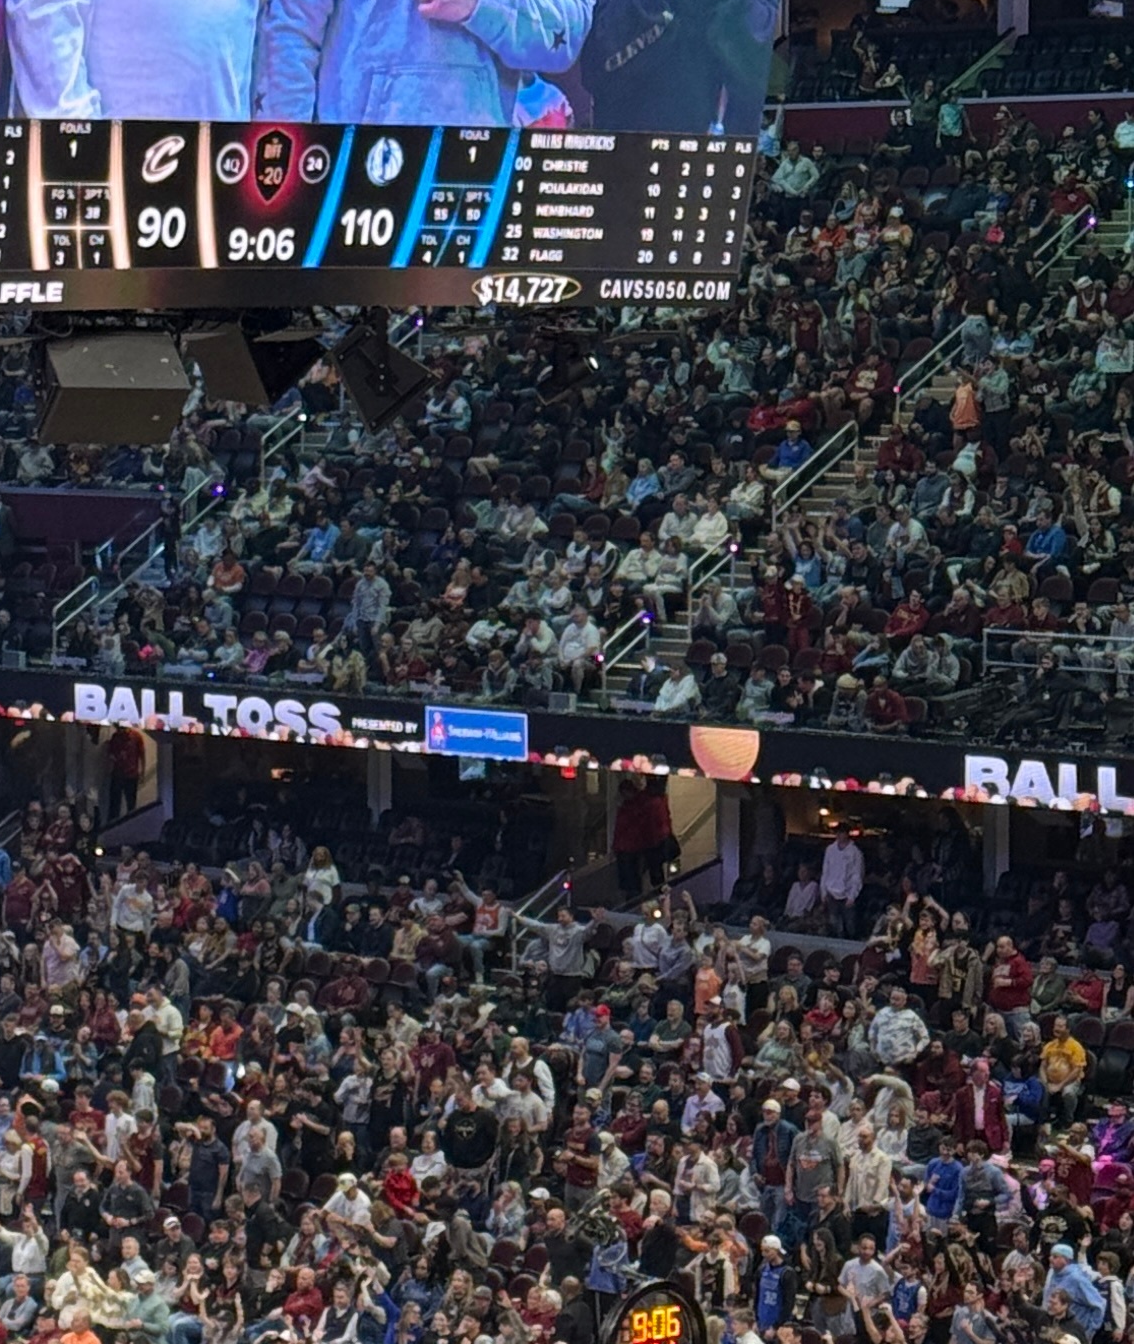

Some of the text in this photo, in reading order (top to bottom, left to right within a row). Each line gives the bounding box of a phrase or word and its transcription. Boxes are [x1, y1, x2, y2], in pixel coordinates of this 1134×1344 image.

[4, 125, 23, 138] FLS
[69, 140, 78, 158] 1
[651, 139, 670, 151] PTS
[5, 150, 15, 165] 2
[468, 146, 477, 163] 1
[306, 158, 322, 171] 24
[515, 156, 532, 171] 00
[650, 161, 659, 175] 4
[681, 162, 690, 176] 2
[735, 164, 745, 178] 0
[3, 175, 10, 190] 1
[517, 179, 524, 193] 1
[647, 183, 661, 197] 10
[731, 186, 741, 199] 3
[0, 199, 7, 215] 1
[645, 207, 655, 219] 11
[674, 206, 684, 220] 3
[729, 208, 736, 221] 1
[136, 206, 186, 249] 90
[341, 209, 394, 246] 110
[505, 224, 522, 238] 25
[672, 229, 683, 242] 11
[696, 229, 705, 242] 2
[725, 230, 734, 243] 2
[228, 227, 296, 261] 9:06
[55, 251, 101, 266] 3 1
[422, 251, 465, 264] 4 1
[502, 246, 519, 261] 32
[637, 250, 653, 263] 20
[668, 250, 678, 264] 6
[478, 275, 567, 307] $14,727
[600, 278, 732, 302] CAVS5050.COM
[73, 682, 191, 732] BALL
[202, 693, 342, 739] TOSS
[632, 1305, 681, 1344] 9:06
